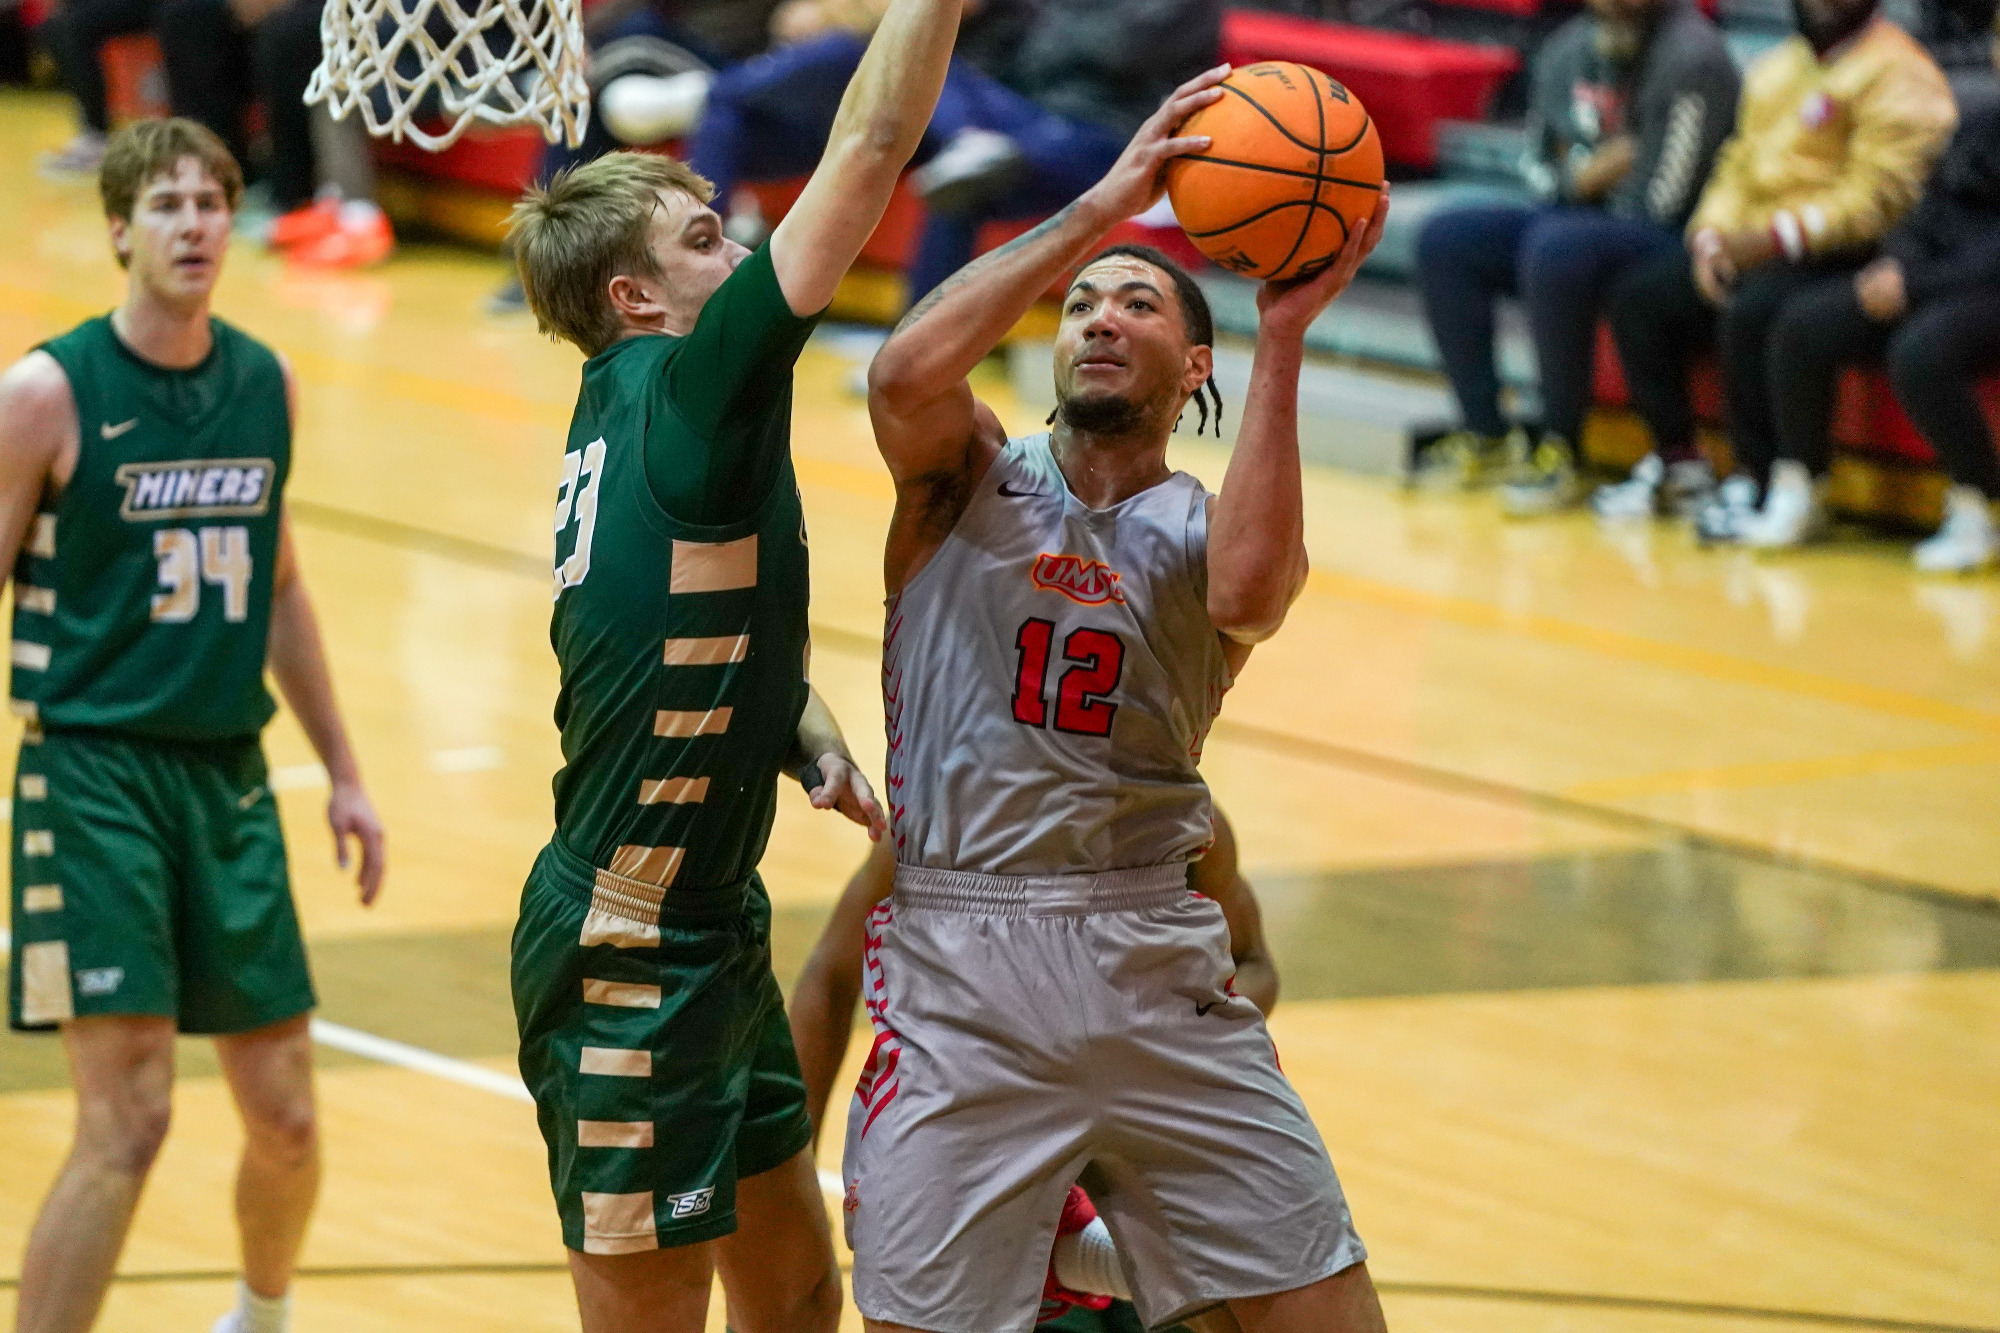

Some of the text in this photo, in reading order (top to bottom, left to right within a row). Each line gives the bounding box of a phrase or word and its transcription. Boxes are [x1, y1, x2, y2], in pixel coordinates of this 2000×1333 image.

[133, 466, 265, 509] MINERS
[150, 526, 253, 624] 34
[1011, 617, 1125, 737] 12
